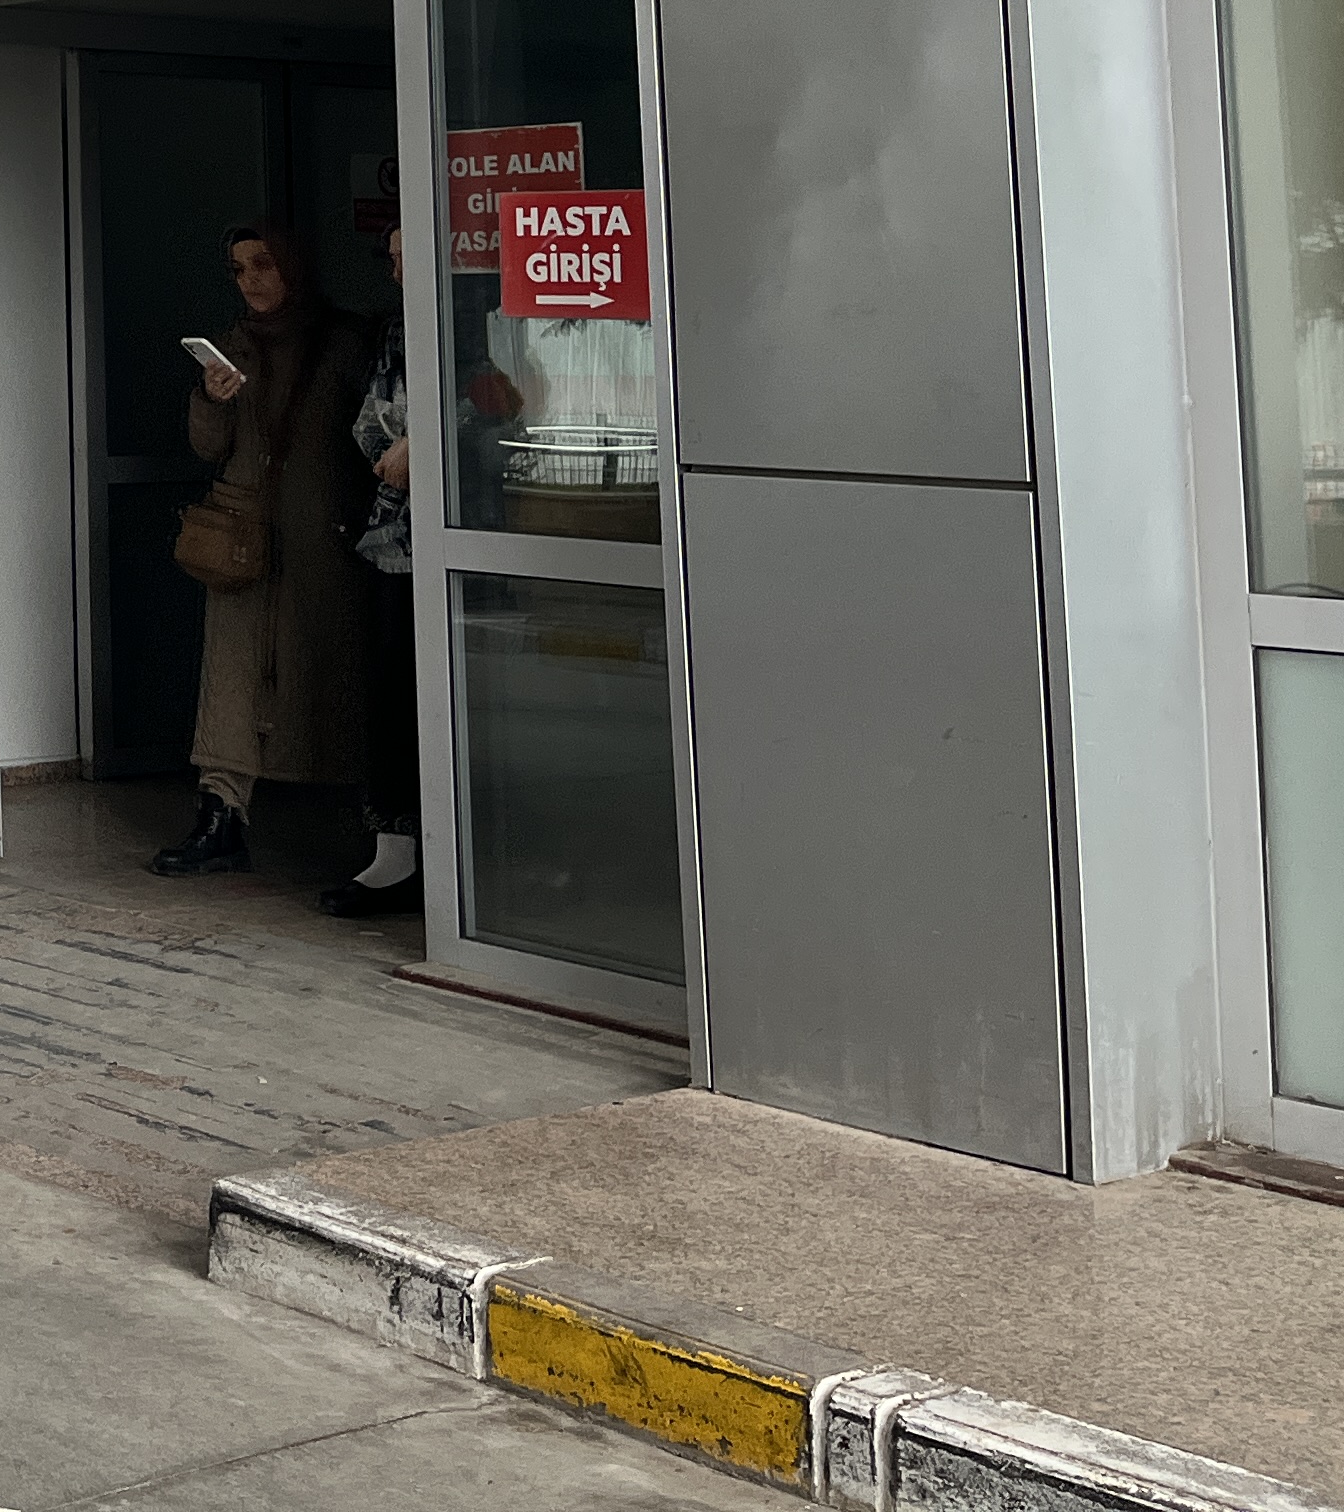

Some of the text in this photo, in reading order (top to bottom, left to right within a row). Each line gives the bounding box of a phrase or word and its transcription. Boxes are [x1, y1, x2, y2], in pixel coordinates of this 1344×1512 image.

[448, 151, 575, 178] OLE ALAN
[515, 205, 632, 237] HASTA
[525, 243, 622, 291] GİRİŞİ
